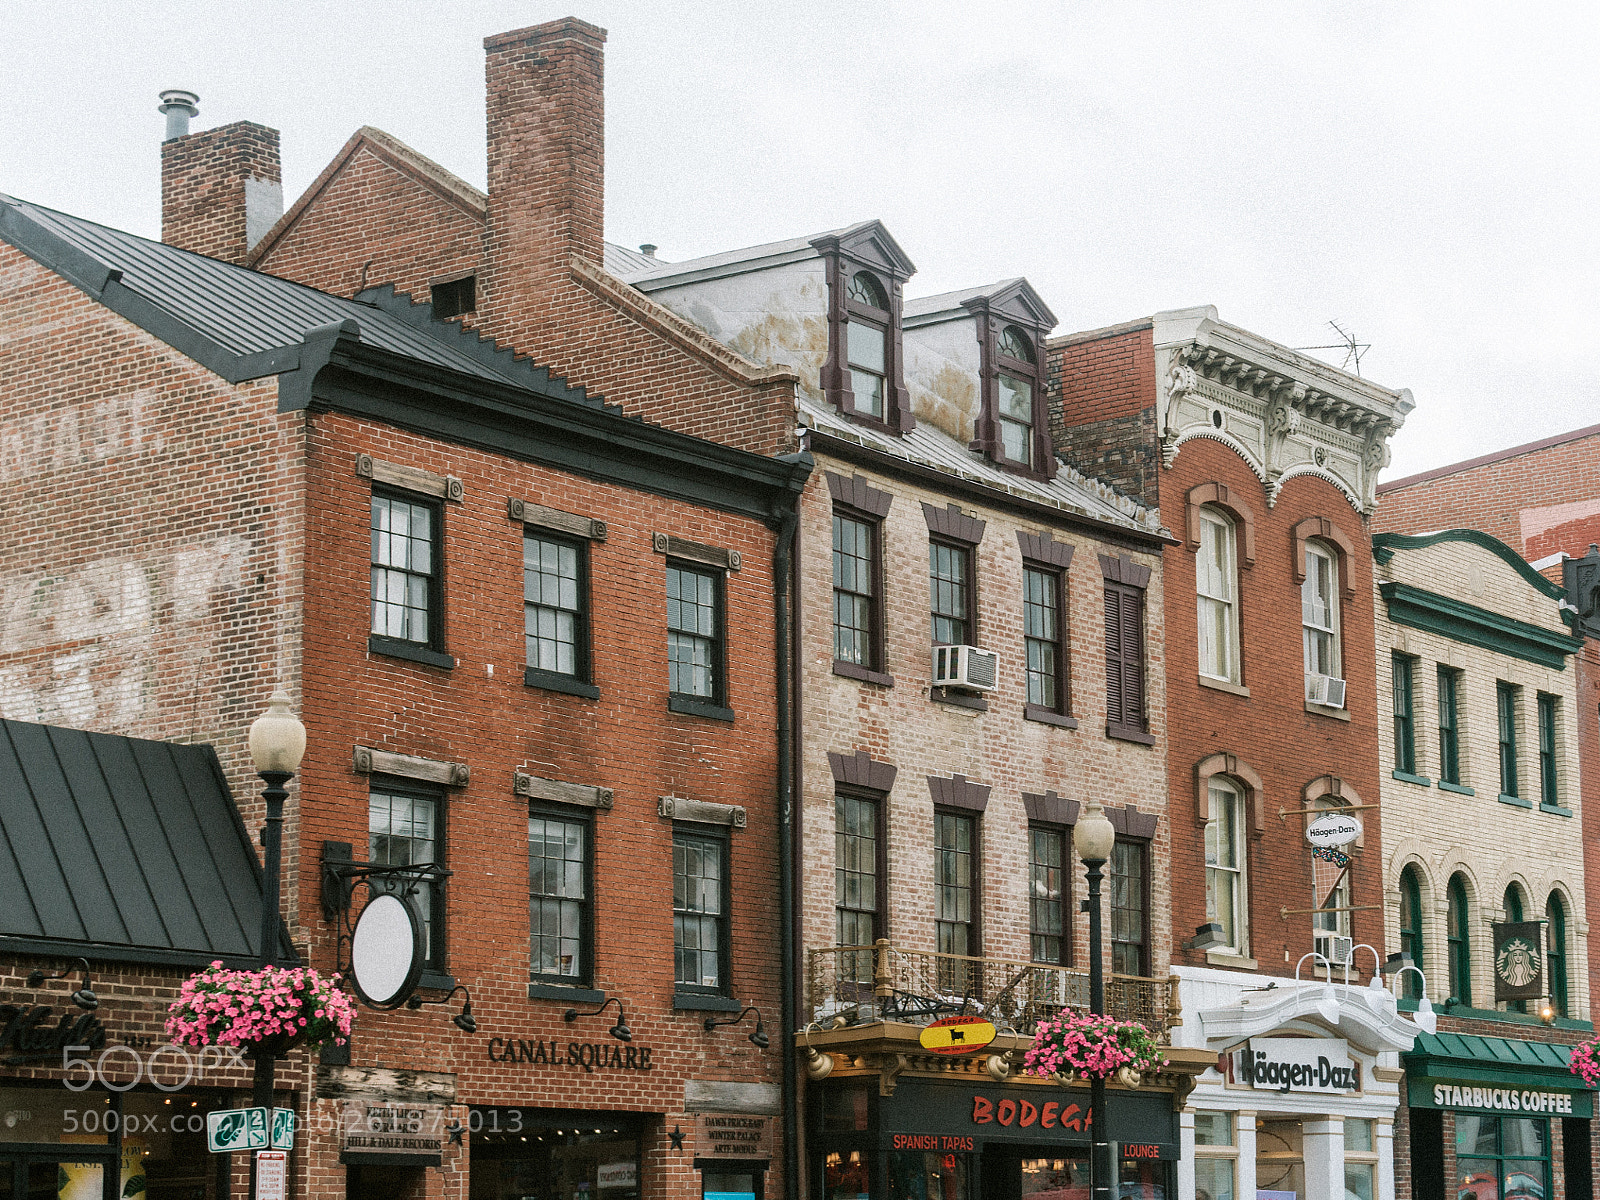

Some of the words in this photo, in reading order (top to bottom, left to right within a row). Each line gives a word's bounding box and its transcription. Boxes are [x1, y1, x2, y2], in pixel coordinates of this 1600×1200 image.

[1310, 826, 1355, 837] Häagen-Dazs
[488, 1037, 564, 1064] CANAL
[568, 1042, 653, 1071] SQUARE
[1241, 1051, 1360, 1094] Häagen-Dazs
[1434, 1084, 1519, 1111] STARBUCKS
[1521, 1090, 1572, 1114] COFFEE
[708, 1130, 736, 1140] WINTER
[893, 1134, 938, 1150] SPANISH
[941, 1137, 973, 1151] TAPAS
[347, 1137, 369, 1147] HILL
[379, 1138, 401, 1148] DALE
[403, 1139, 441, 1150] RECORDS
[1124, 1144, 1159, 1158] LOUNGE
